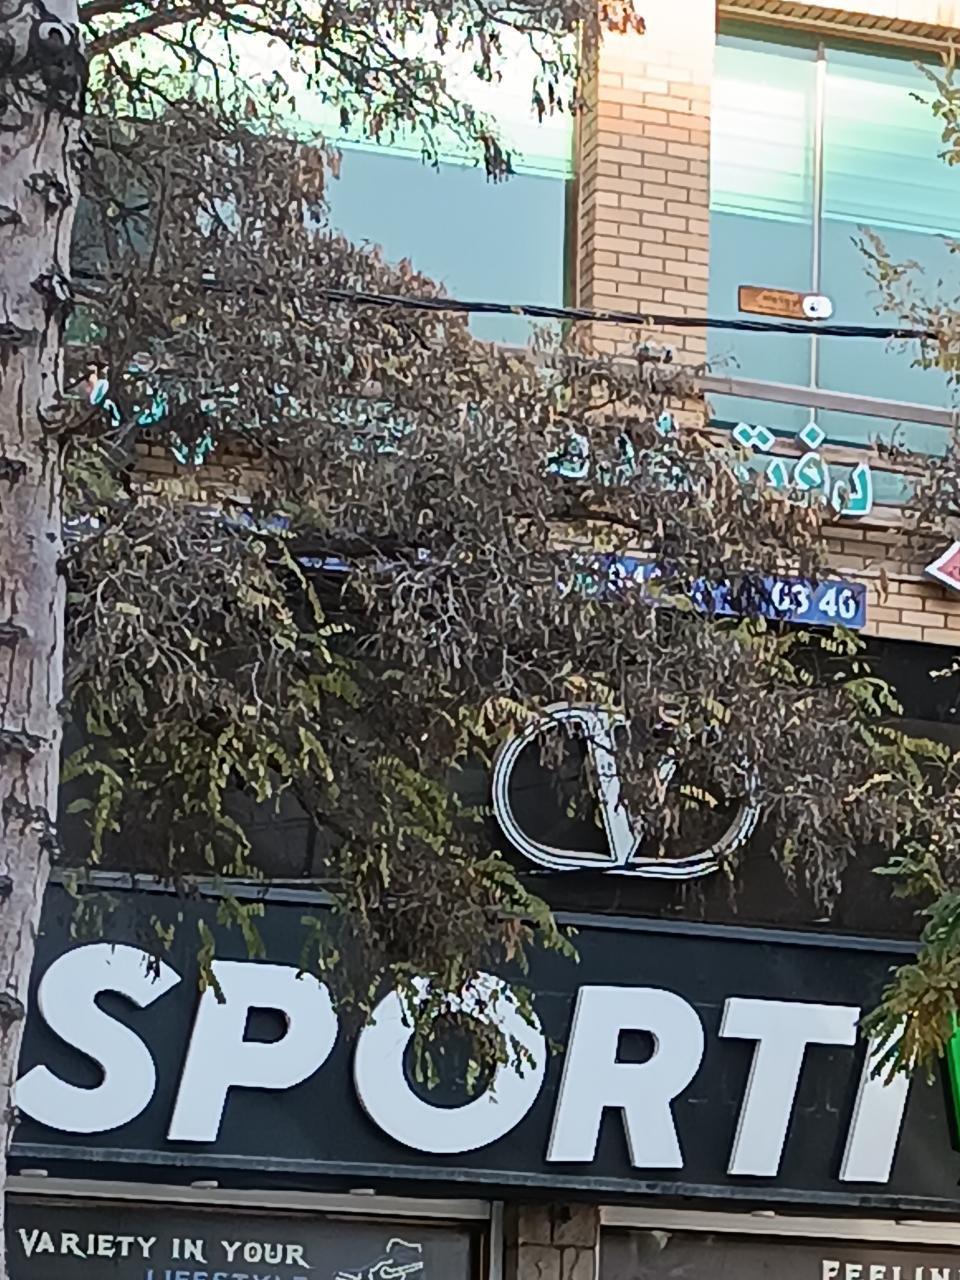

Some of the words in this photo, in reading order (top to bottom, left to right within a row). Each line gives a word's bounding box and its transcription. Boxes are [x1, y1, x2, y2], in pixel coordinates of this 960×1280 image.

[19, 1228, 157, 1260] VARIETY
[172, 1238, 207, 1264] IN
[222, 1240, 311, 1268] YOUR
